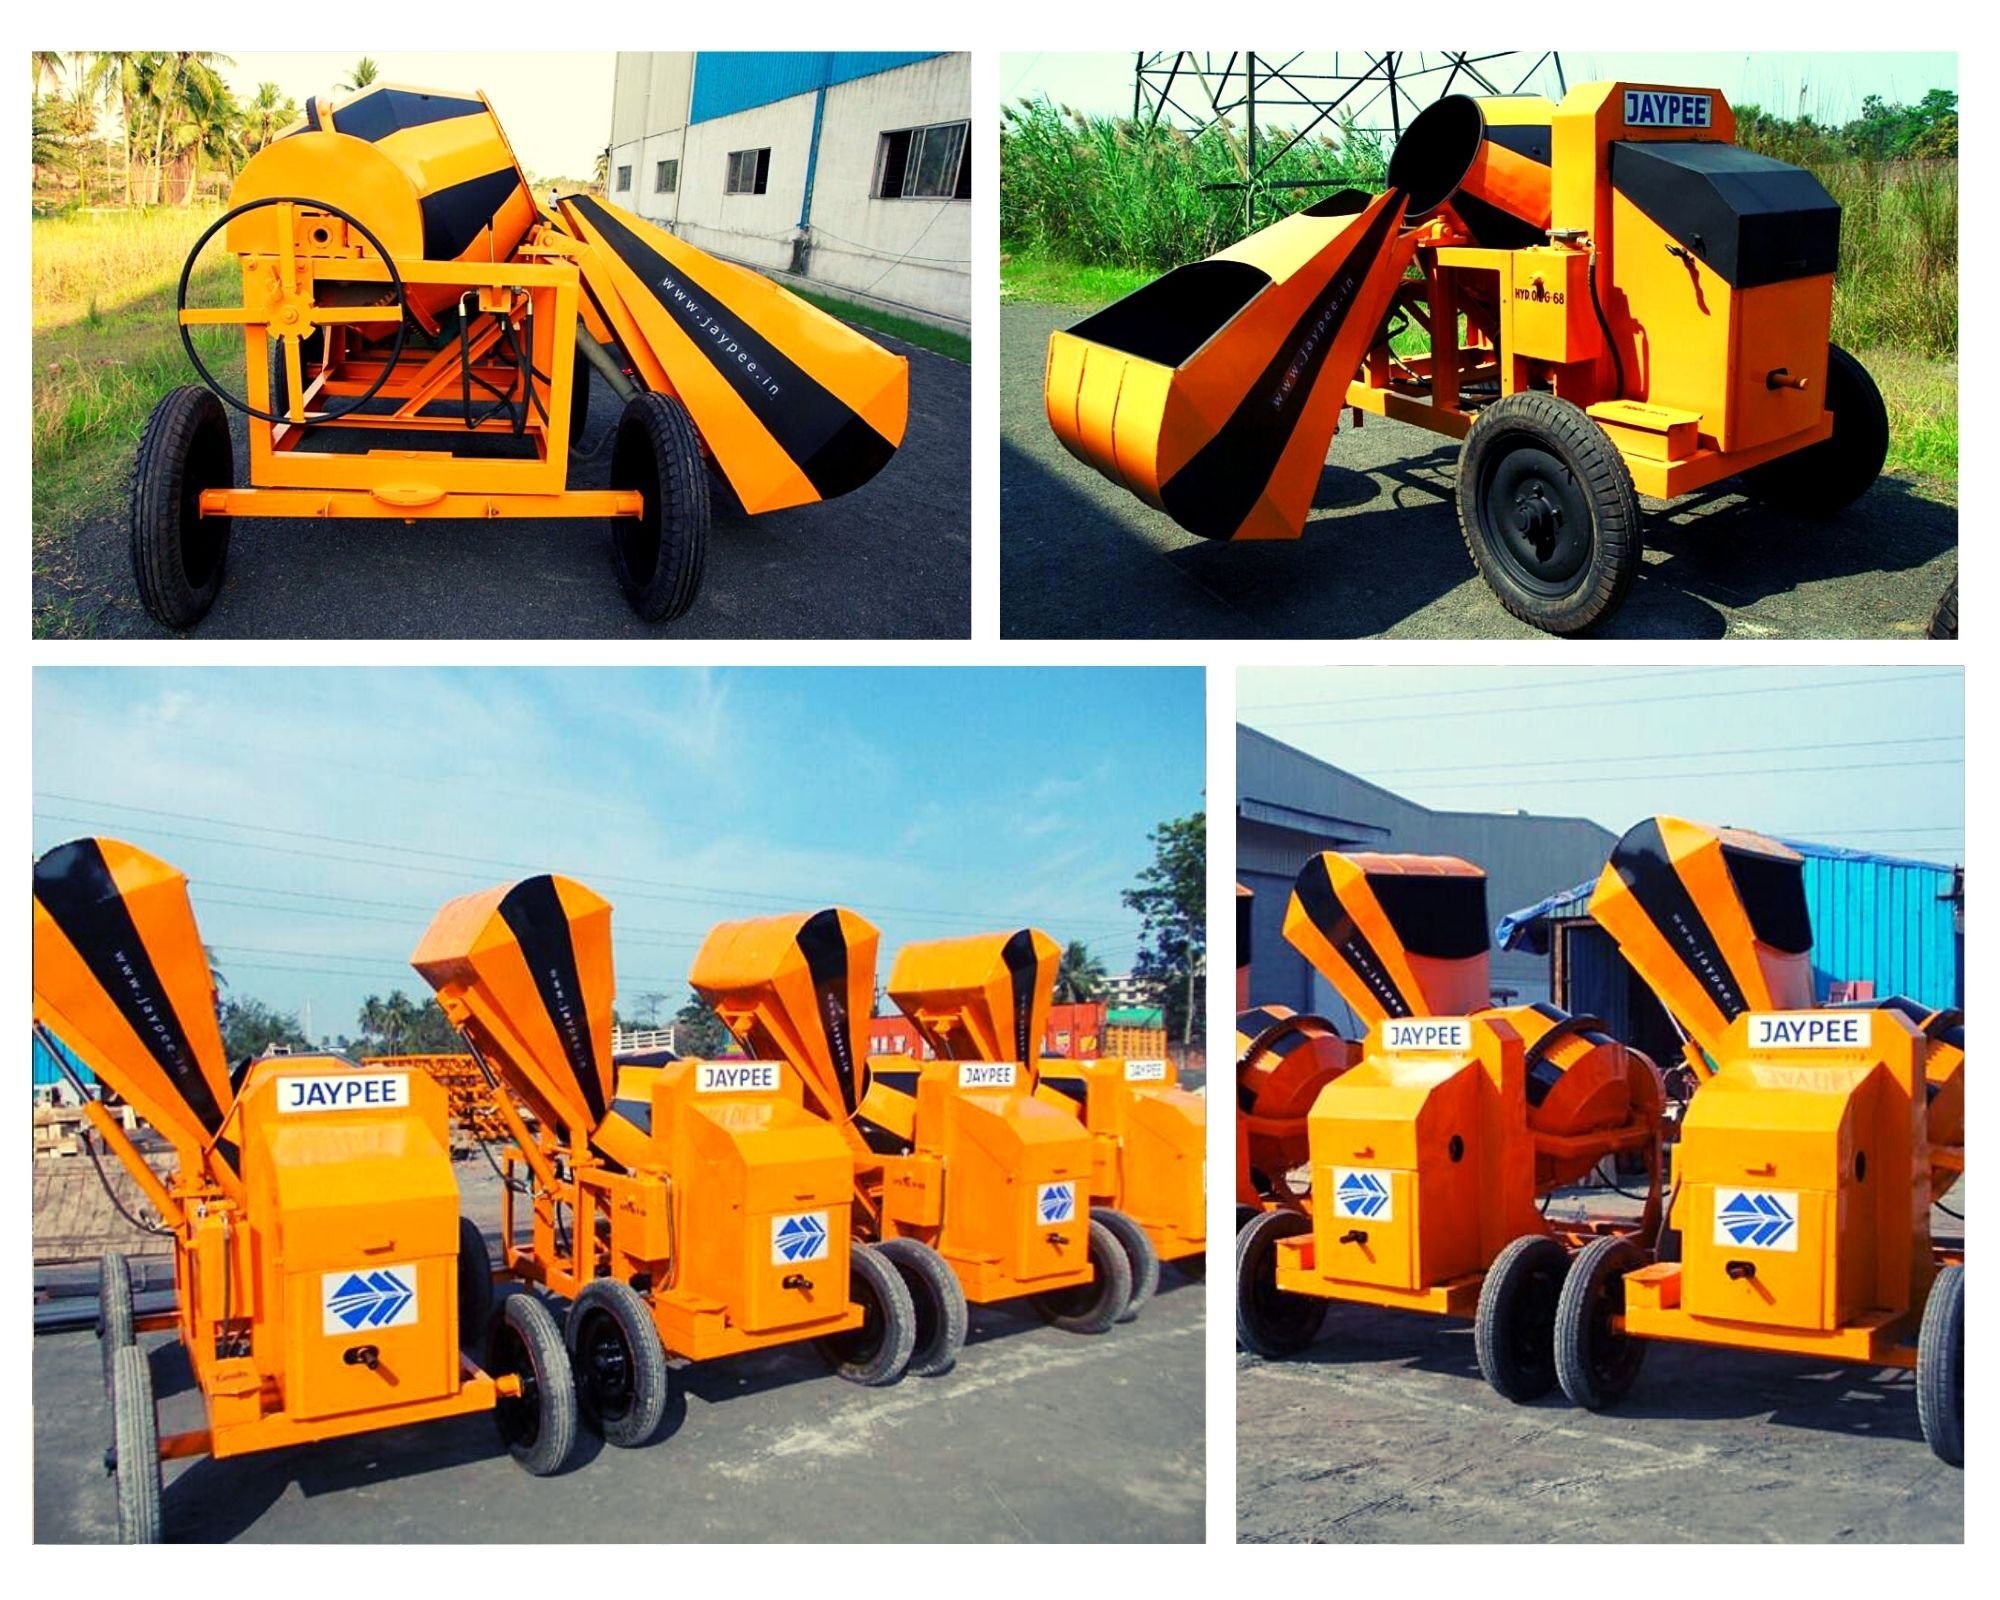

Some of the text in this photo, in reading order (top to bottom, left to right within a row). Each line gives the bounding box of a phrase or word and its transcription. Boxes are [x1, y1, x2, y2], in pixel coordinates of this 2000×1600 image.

[1627, 93, 1707, 125] JAYPEE
[662, 277, 779, 395] www.jaypee.in
[1273, 278, 1354, 409] www.jaypee.in
[114, 951, 189, 1075] www.jaypee.in
[1391, 1026, 1462, 1046] JAYPEE
[1760, 1019, 1858, 1043] JAYPEE
[705, 1067, 772, 1088] JAYPEE
[965, 1067, 1011, 1083] JAYPEE
[291, 1080, 397, 1106] JAYPEE
